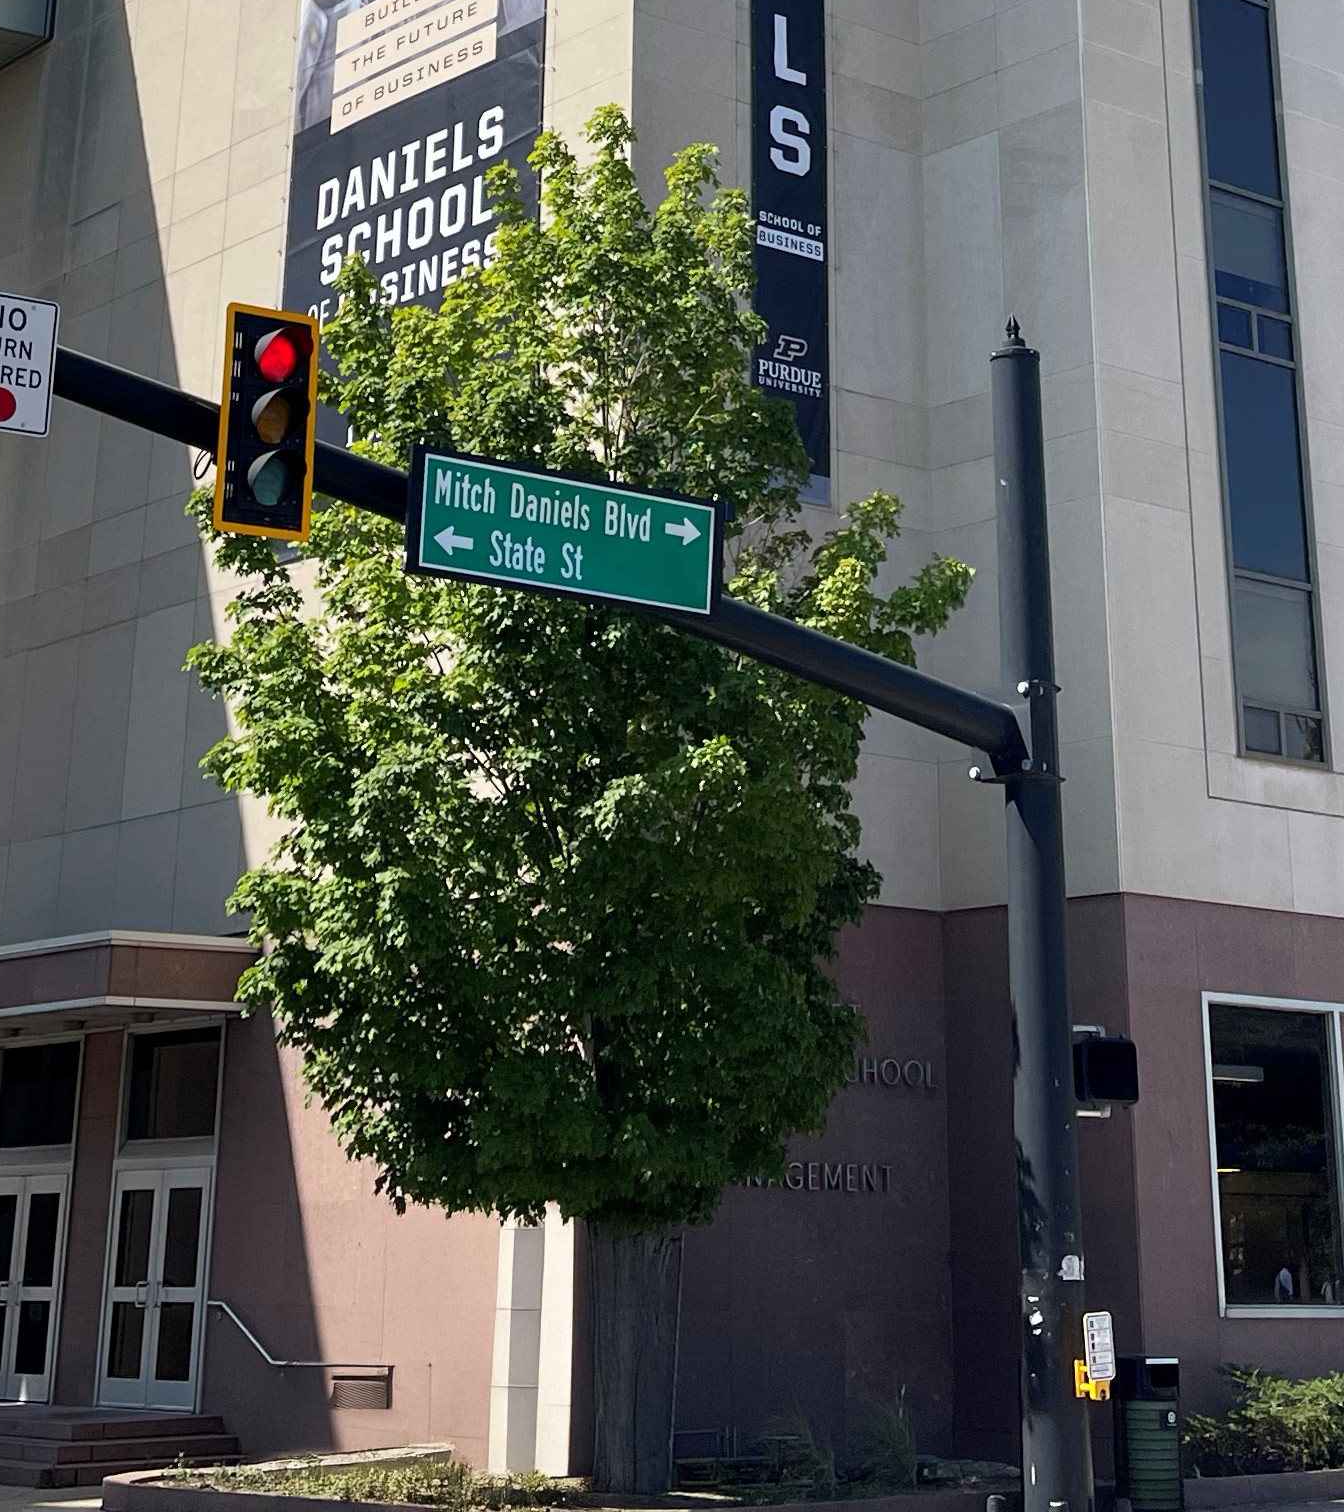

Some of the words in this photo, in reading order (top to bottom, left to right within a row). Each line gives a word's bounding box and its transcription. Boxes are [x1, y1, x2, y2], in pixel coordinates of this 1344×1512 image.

[351, 43, 387, 73] THE
[396, 2, 479, 52] FUTURE
[341, 94, 365, 117] OF
[373, 41, 485, 102] BUSINESS
[316, 105, 505, 231] DANIELS
[319, 175, 494, 287] SCHOOL
[758, 210, 805, 233] SCHOOL
[807, 224, 822, 237] OF
[758, 230, 822, 257] BUSINESS
[338, 231, 502, 311] SINESS
[0, 366, 42, 389] RED
[758, 359, 822, 388] PURDUE
[758, 376, 822, 398] UNIVERSITY
[434, 468, 496, 514] Mitch
[510, 482, 590, 531] Daniels
[605, 500, 651, 542] Blvd
[489, 530, 546, 574] State
[560, 542, 584, 581] St
[844, 1058, 938, 1088] HOOL
[737, 1162, 894, 1193] GEMENT
